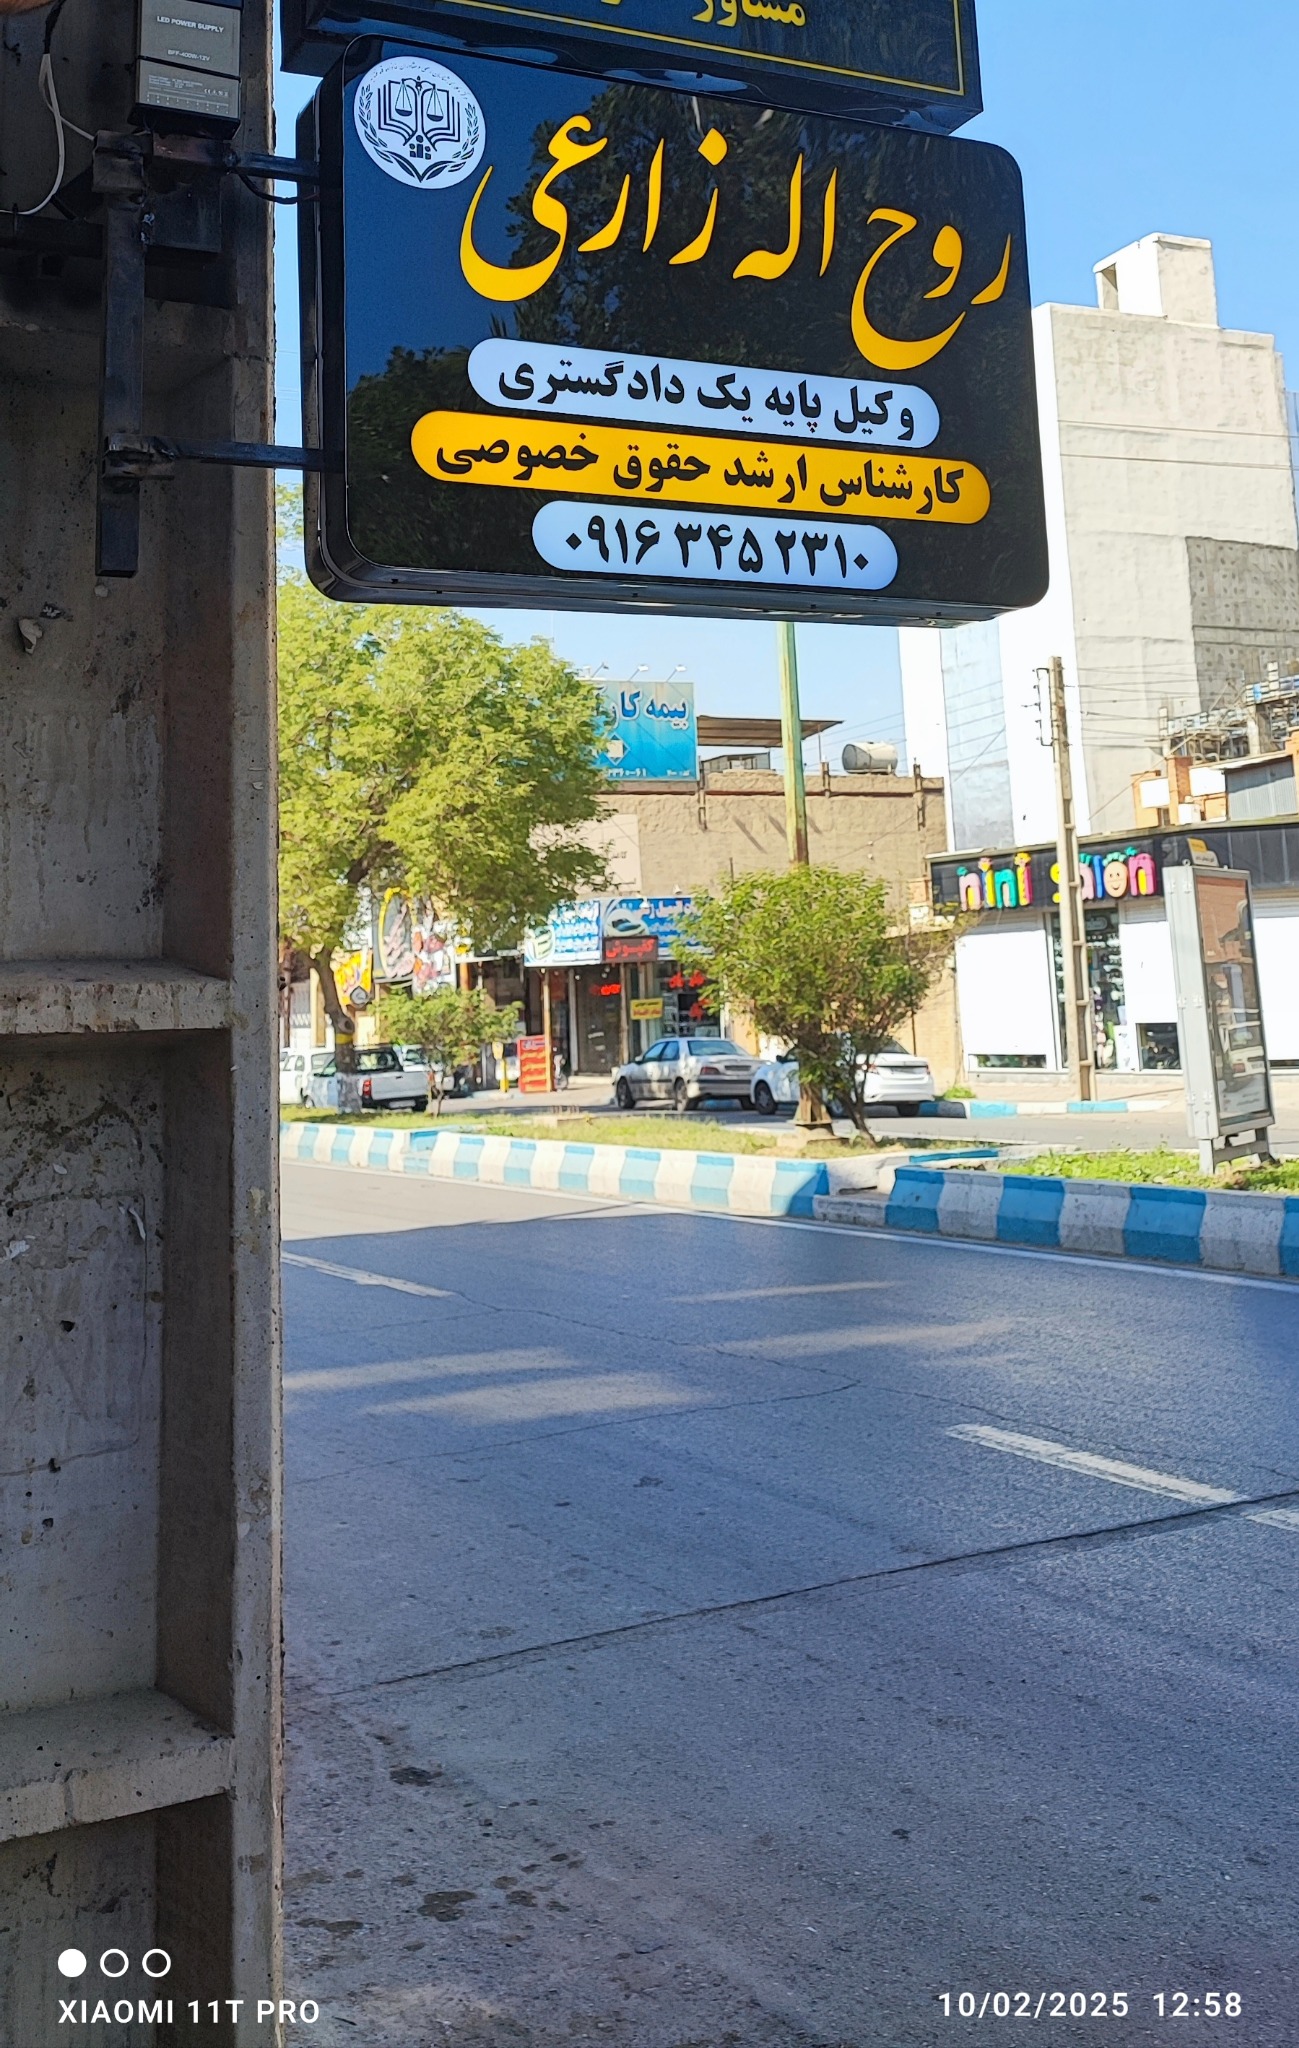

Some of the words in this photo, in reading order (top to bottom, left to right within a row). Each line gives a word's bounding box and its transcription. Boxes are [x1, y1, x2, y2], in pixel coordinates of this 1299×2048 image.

[156, 15, 170, 24] LED
[171, 18, 197, 29] POWER
[197, 23, 224, 33] SUPPLY
[459, 115, 728, 302] زارعی
[732, 152, 837, 280] اله
[851, 208, 1012, 371] روح
[498, 360, 685, 405] دادگستری
[697, 373, 753, 423] یک
[764, 379, 822, 433] پایه
[834, 381, 915, 440] وکیل
[436, 433, 600, 481] خصوصی
[613, 443, 711, 493] حقوق
[723, 451, 807, 504] ارشد
[819, 459, 964, 515] کارشناس
[565, 514, 660, 565] ۰۹۱۶
[673, 522, 764, 574] ۳۴۵
[778, 529, 870, 579] ۲۳۱۰
[645, 698, 688, 729] بیمه
[956, 851, 1034, 912] nini
